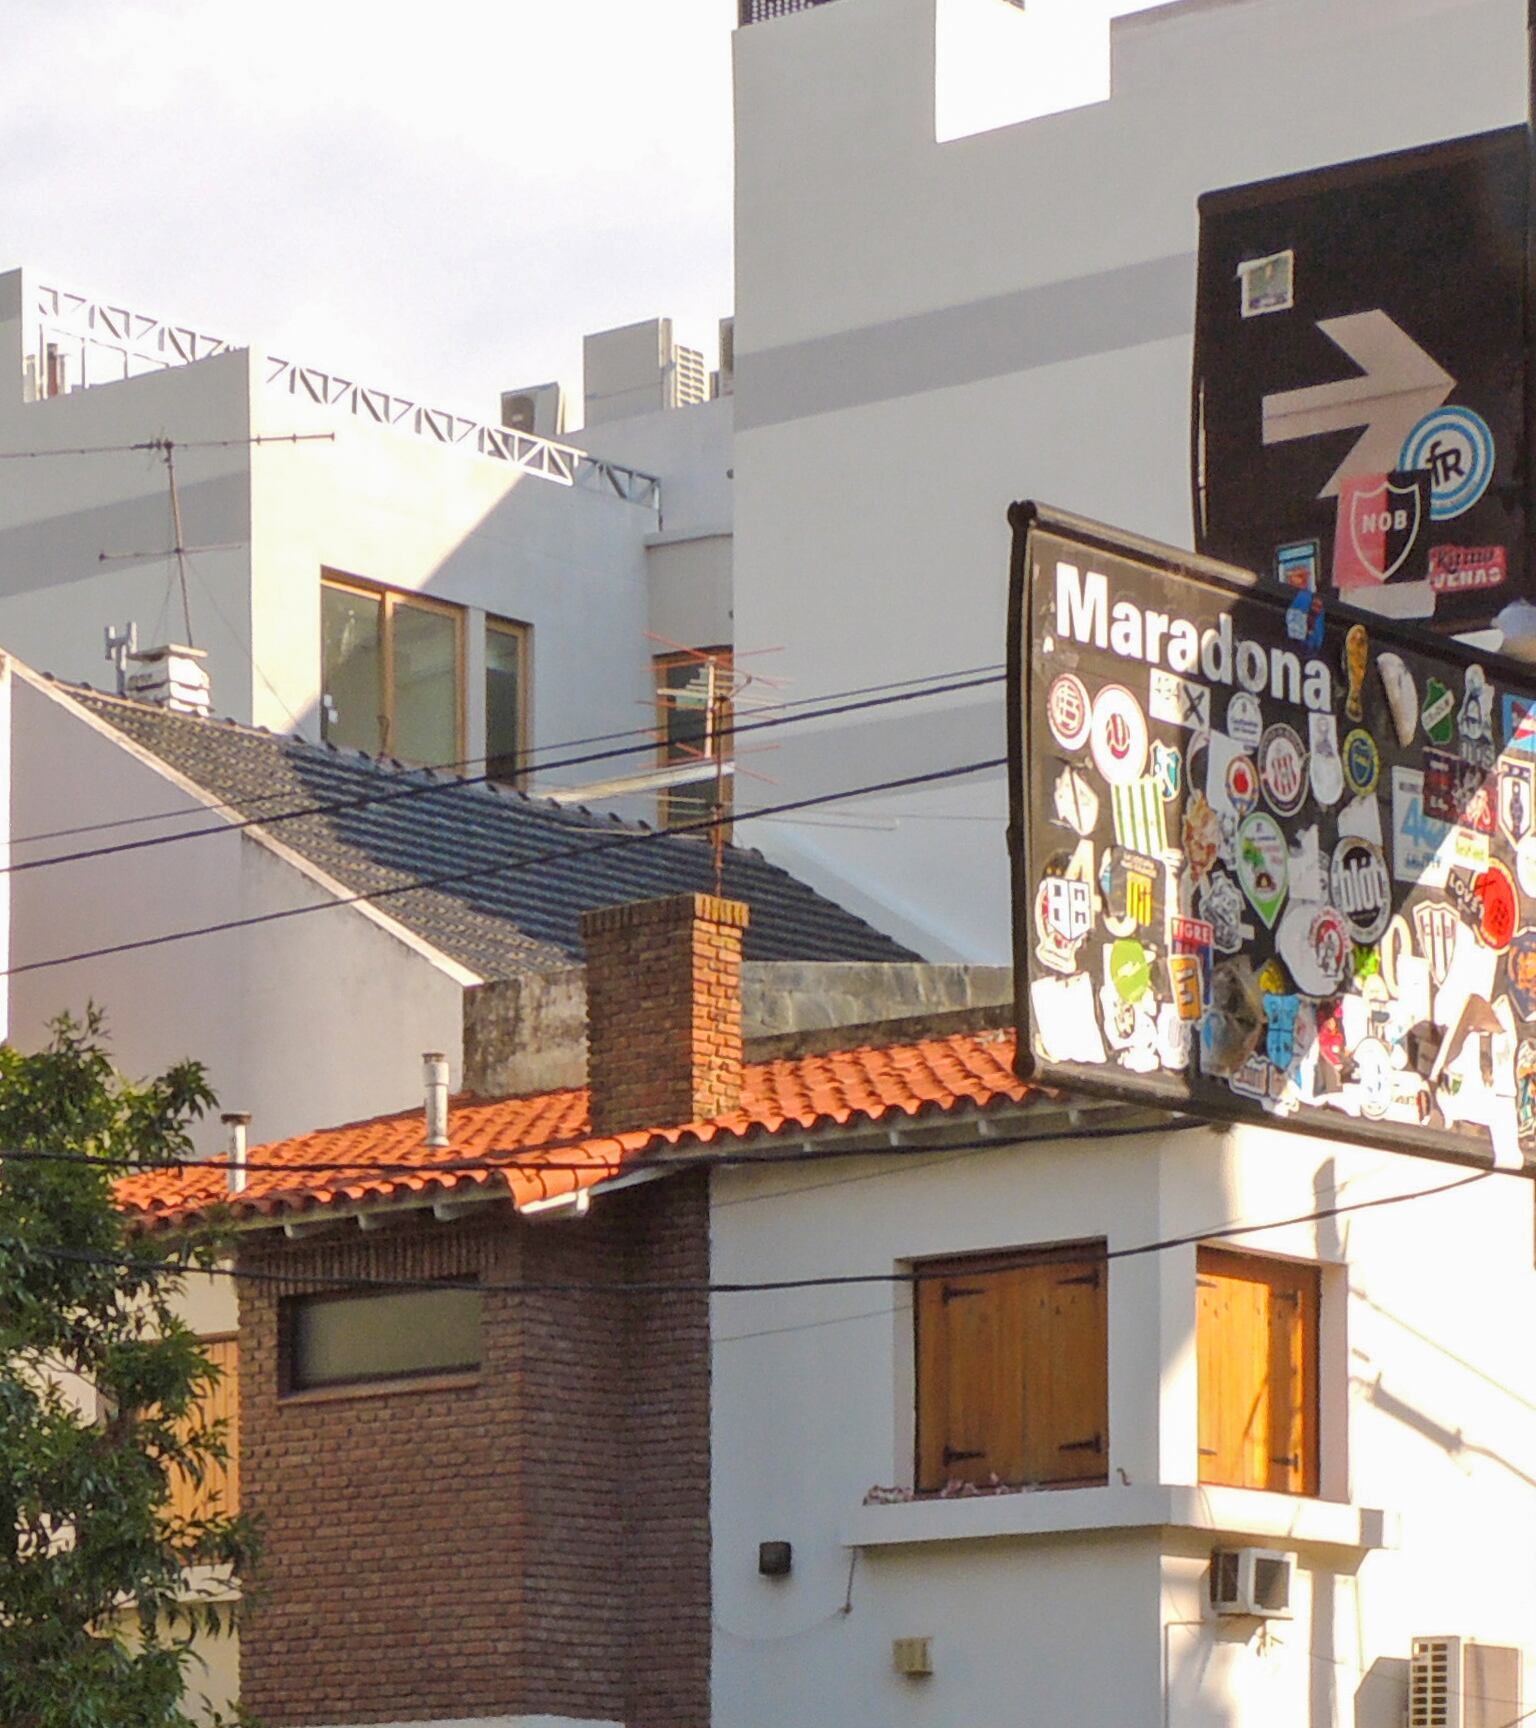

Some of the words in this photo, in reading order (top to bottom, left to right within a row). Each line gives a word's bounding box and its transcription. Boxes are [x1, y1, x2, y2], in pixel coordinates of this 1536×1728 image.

[1363, 510, 1407, 533] NOB
[1056, 562, 1333, 713] Maradona
[1172, 919, 1214, 945] TIGRE
